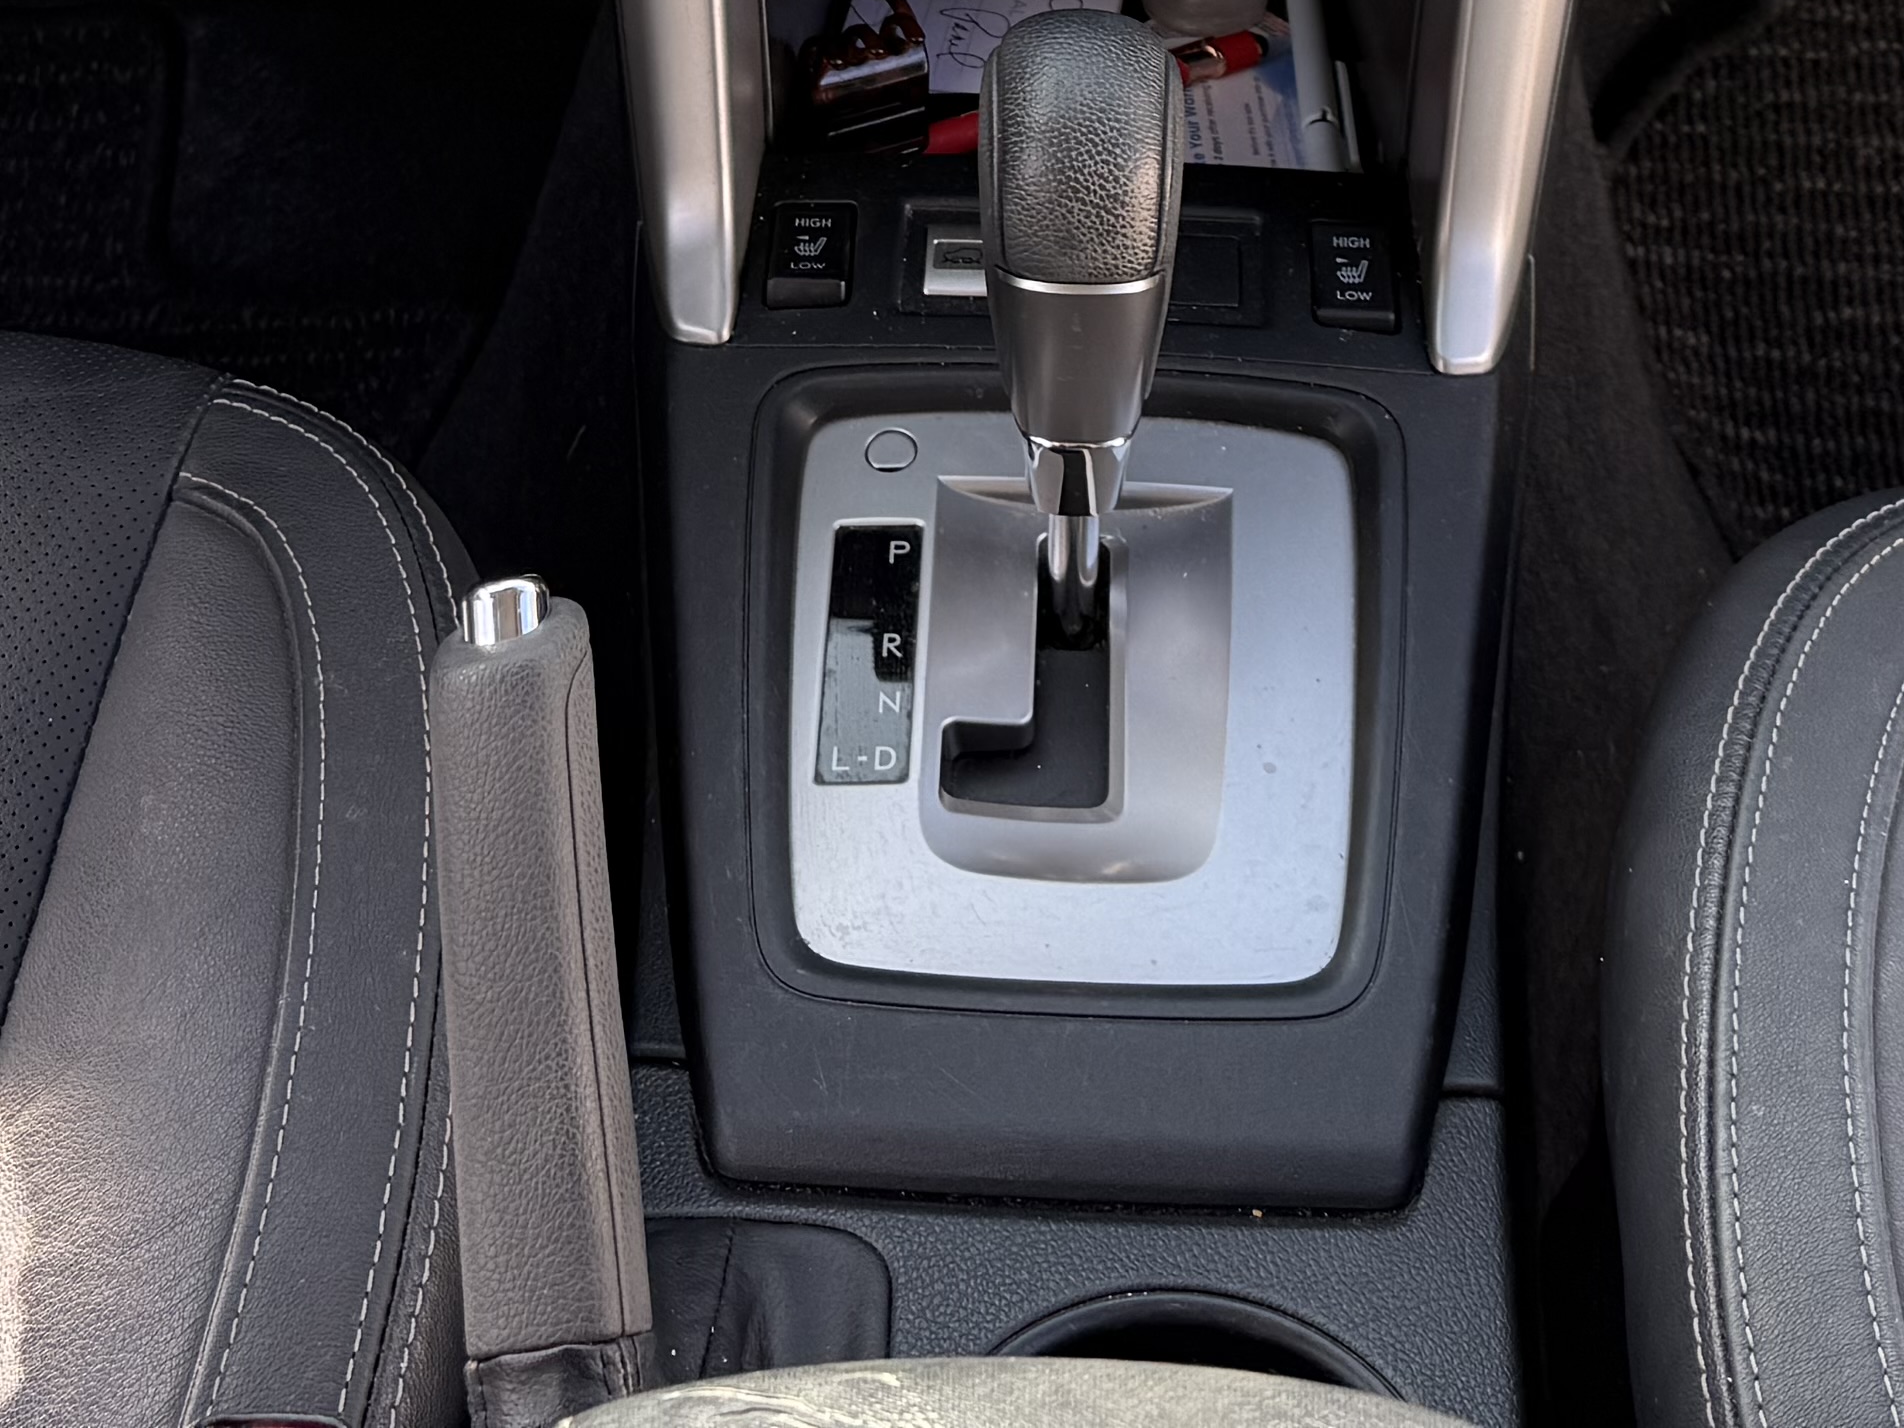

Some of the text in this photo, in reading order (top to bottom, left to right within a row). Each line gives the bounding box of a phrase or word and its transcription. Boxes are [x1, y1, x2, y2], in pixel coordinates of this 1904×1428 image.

[1187, 120, 1202, 149] Your
[794, 217, 833, 228] HIGH
[1332, 236, 1371, 249] HIGH
[790, 261, 826, 270] LOW
[1336, 290, 1373, 301] LOW
[888, 540, 911, 565] P
[882, 632, 904, 658] R
[878, 690, 901, 714] N
